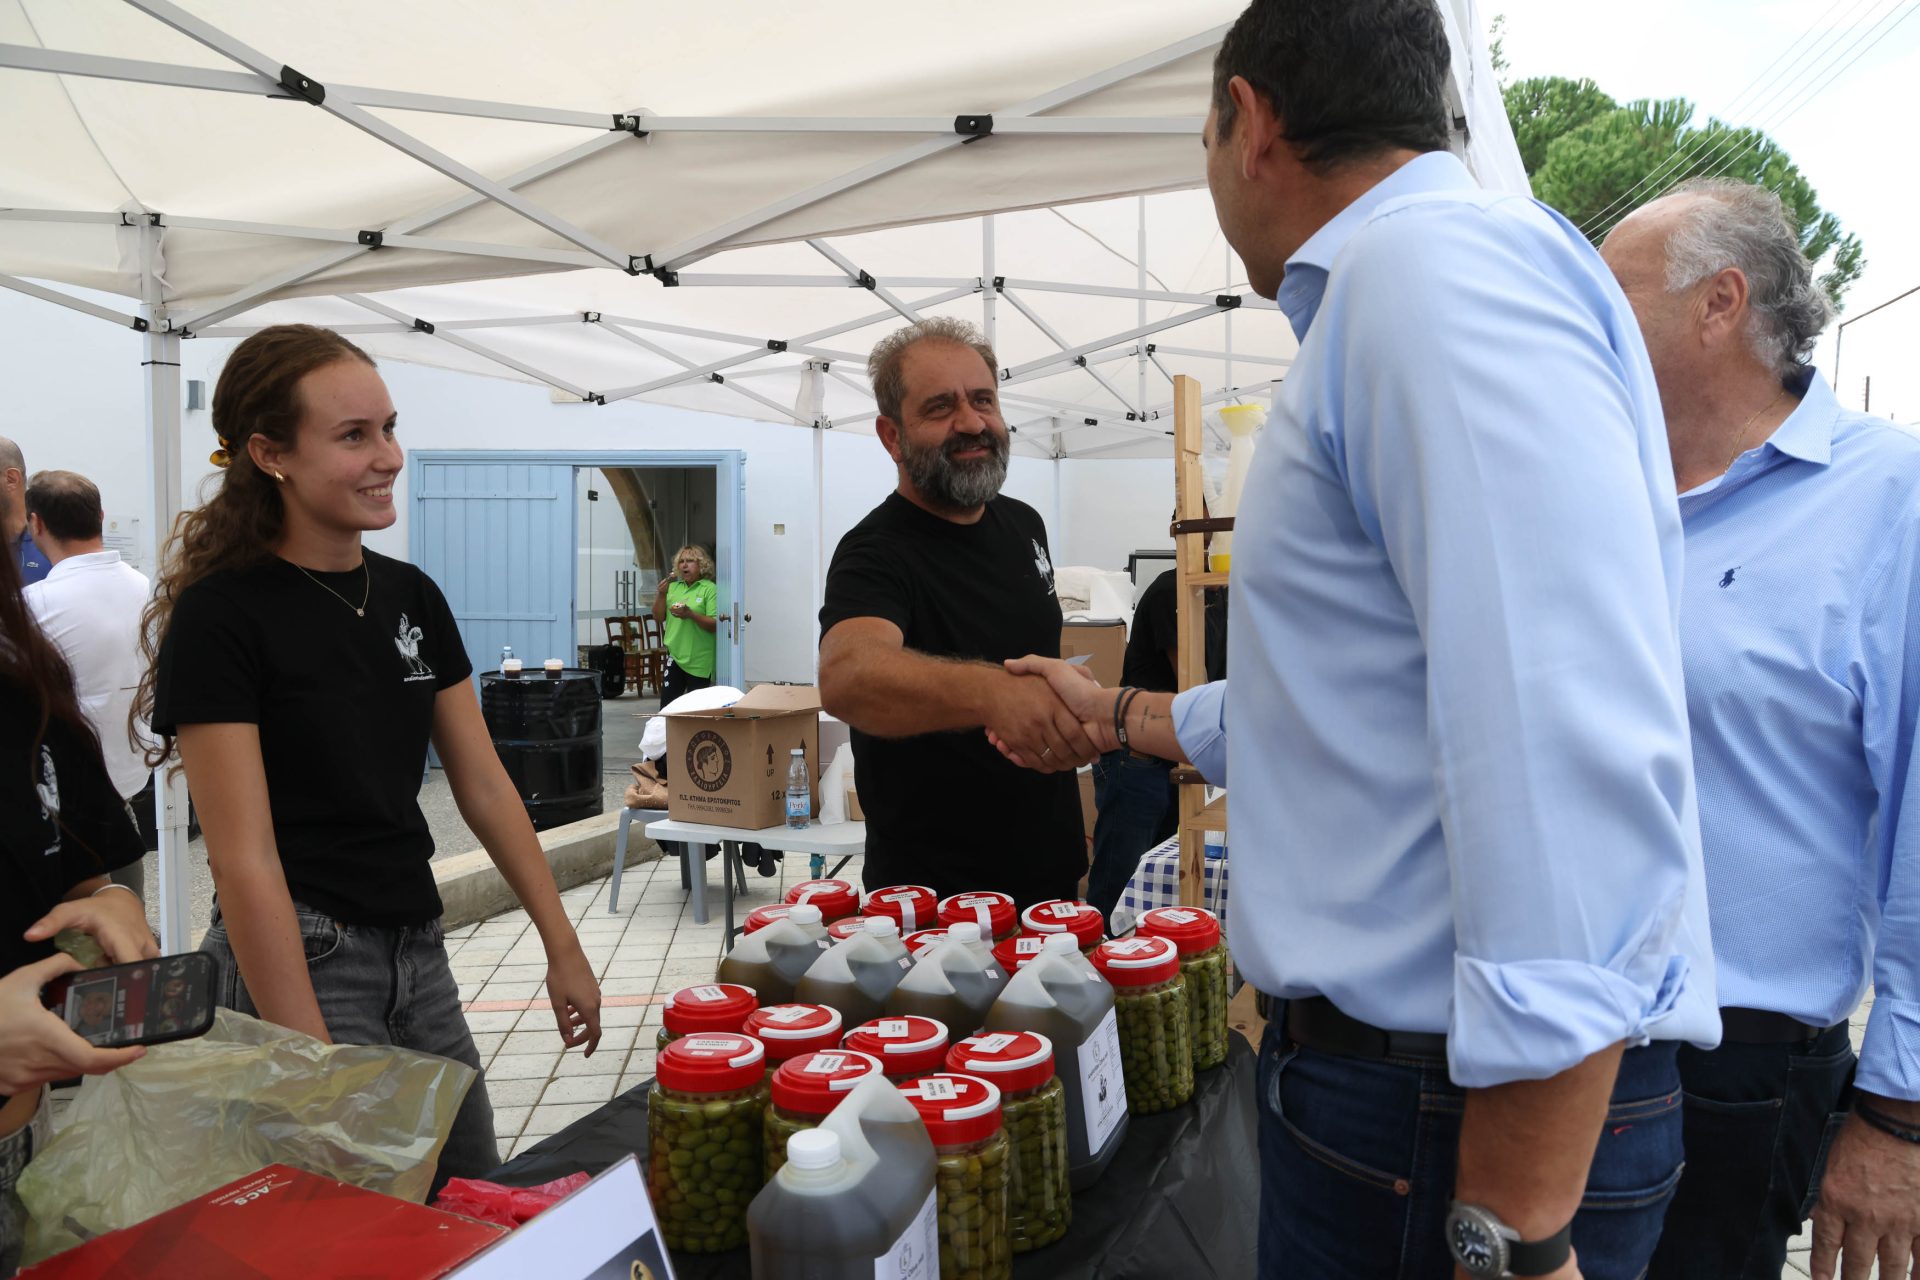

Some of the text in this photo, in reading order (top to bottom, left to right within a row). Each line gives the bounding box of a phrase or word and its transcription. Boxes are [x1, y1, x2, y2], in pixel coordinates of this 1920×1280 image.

[767, 769, 775, 777] UP
[771, 790, 780, 801] 12
[234, 1185, 270, 1206] ACS
